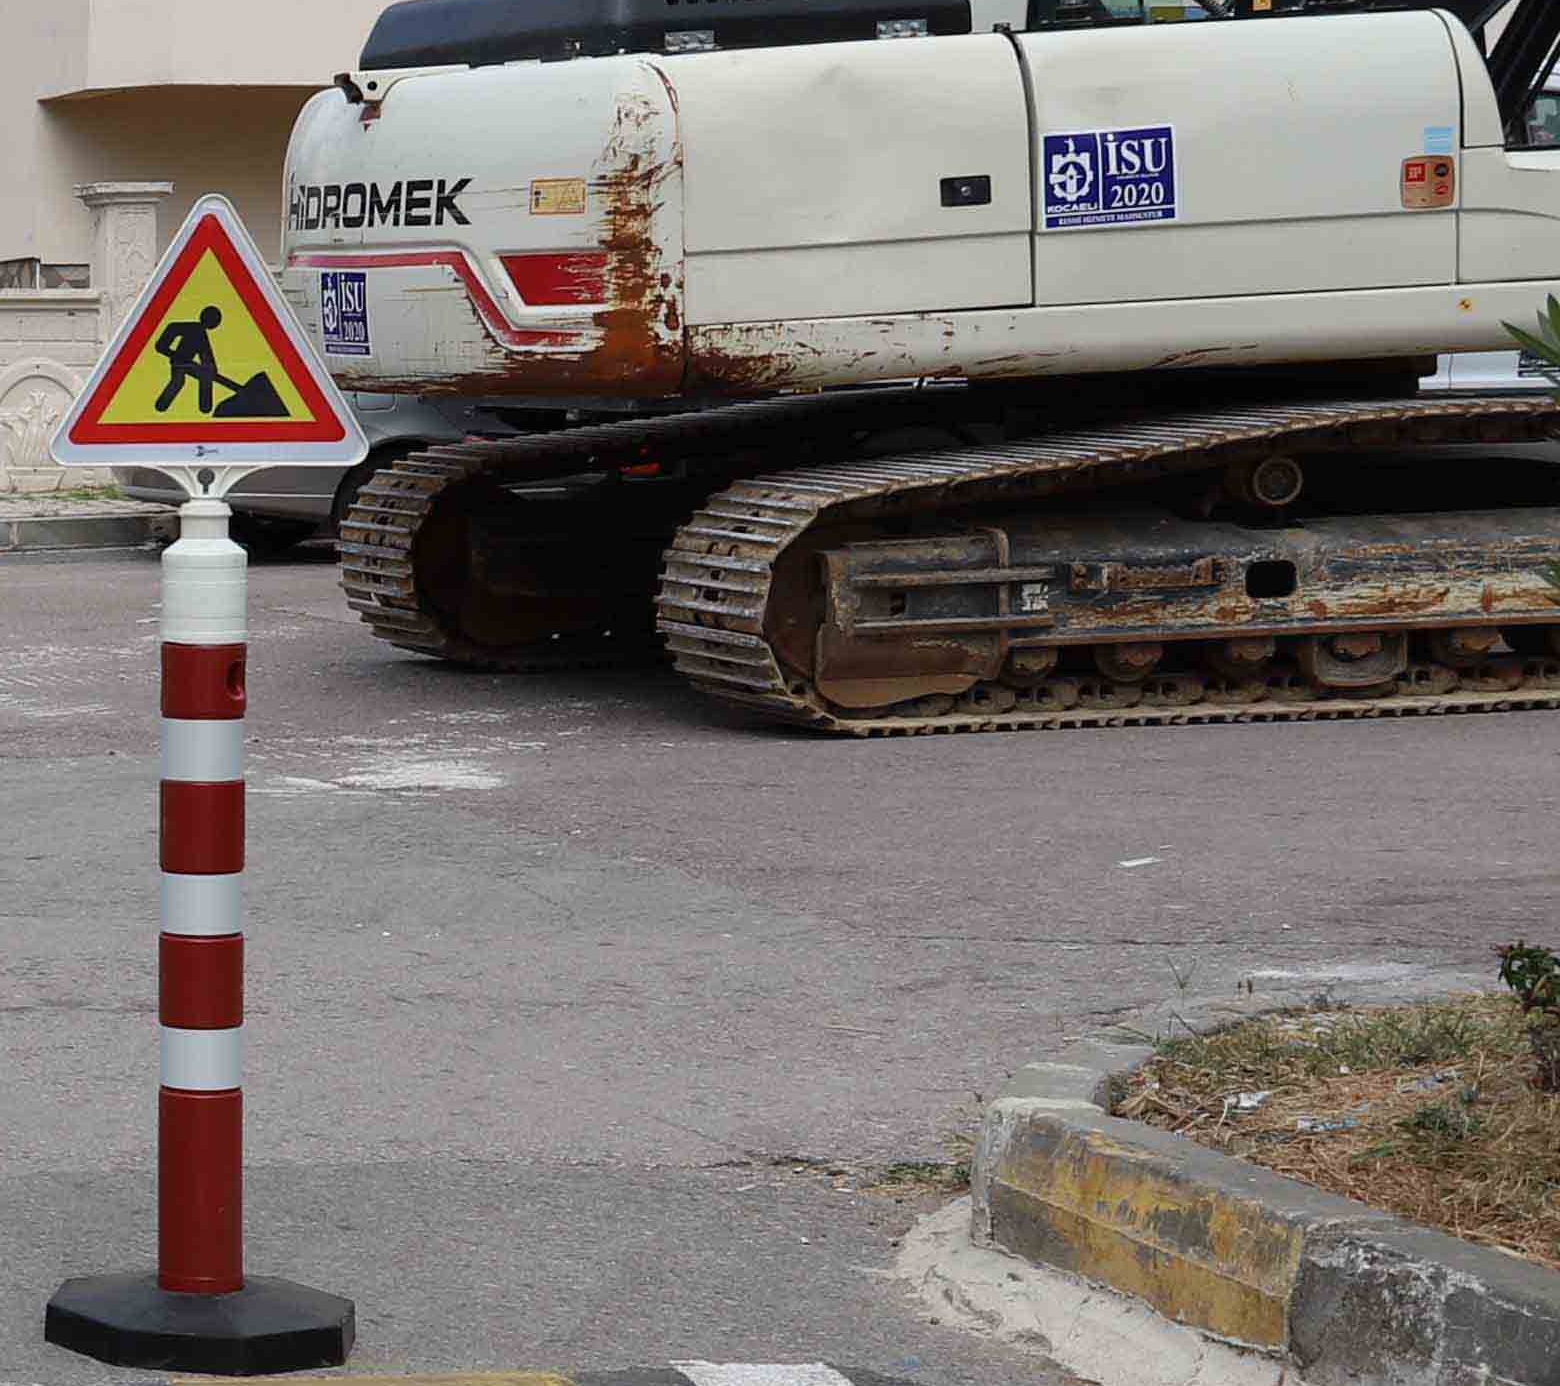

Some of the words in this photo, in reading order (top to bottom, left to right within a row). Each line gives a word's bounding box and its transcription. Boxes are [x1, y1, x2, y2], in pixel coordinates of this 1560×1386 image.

[1104, 133, 1169, 175] İSU
[1111, 181, 1165, 207] 2020
[340, 274, 365, 312] İSU
[343, 321, 366, 341] 2020
